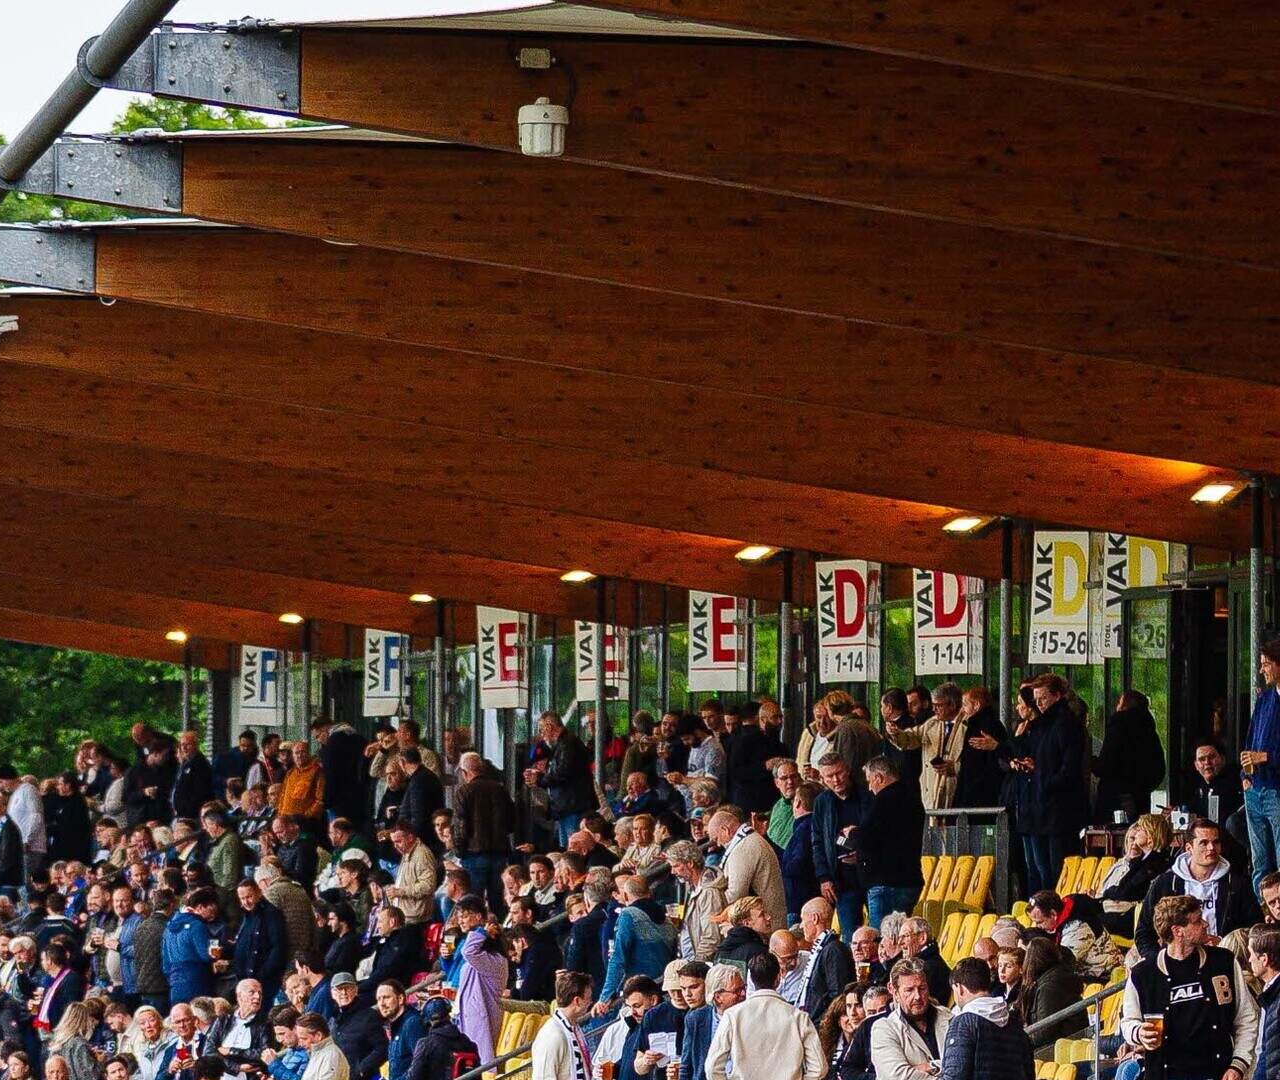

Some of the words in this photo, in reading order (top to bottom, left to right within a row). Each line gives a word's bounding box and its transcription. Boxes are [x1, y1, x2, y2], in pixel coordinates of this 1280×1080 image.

[1034, 542, 1053, 615] VAK
[1052, 541, 1087, 616] D
[1106, 533, 1127, 607] VAK
[820, 571, 835, 638] VAK
[834, 569, 866, 638] D
[933, 571, 967, 628] D
[481, 625, 494, 681] VAK
[499, 622, 521, 681] E
[693, 598, 707, 662] VAK
[712, 597, 737, 662] E
[932, 643, 964, 664] 1-14
[1039, 631, 1087, 655] 15-26
[244, 652, 257, 701] VAK
[260, 651, 277, 702] F
[368, 637, 380, 691] VAK
[384, 636, 400, 691] F
[835, 651, 863, 673] 1-14
[1212, 975, 1233, 1006] B
